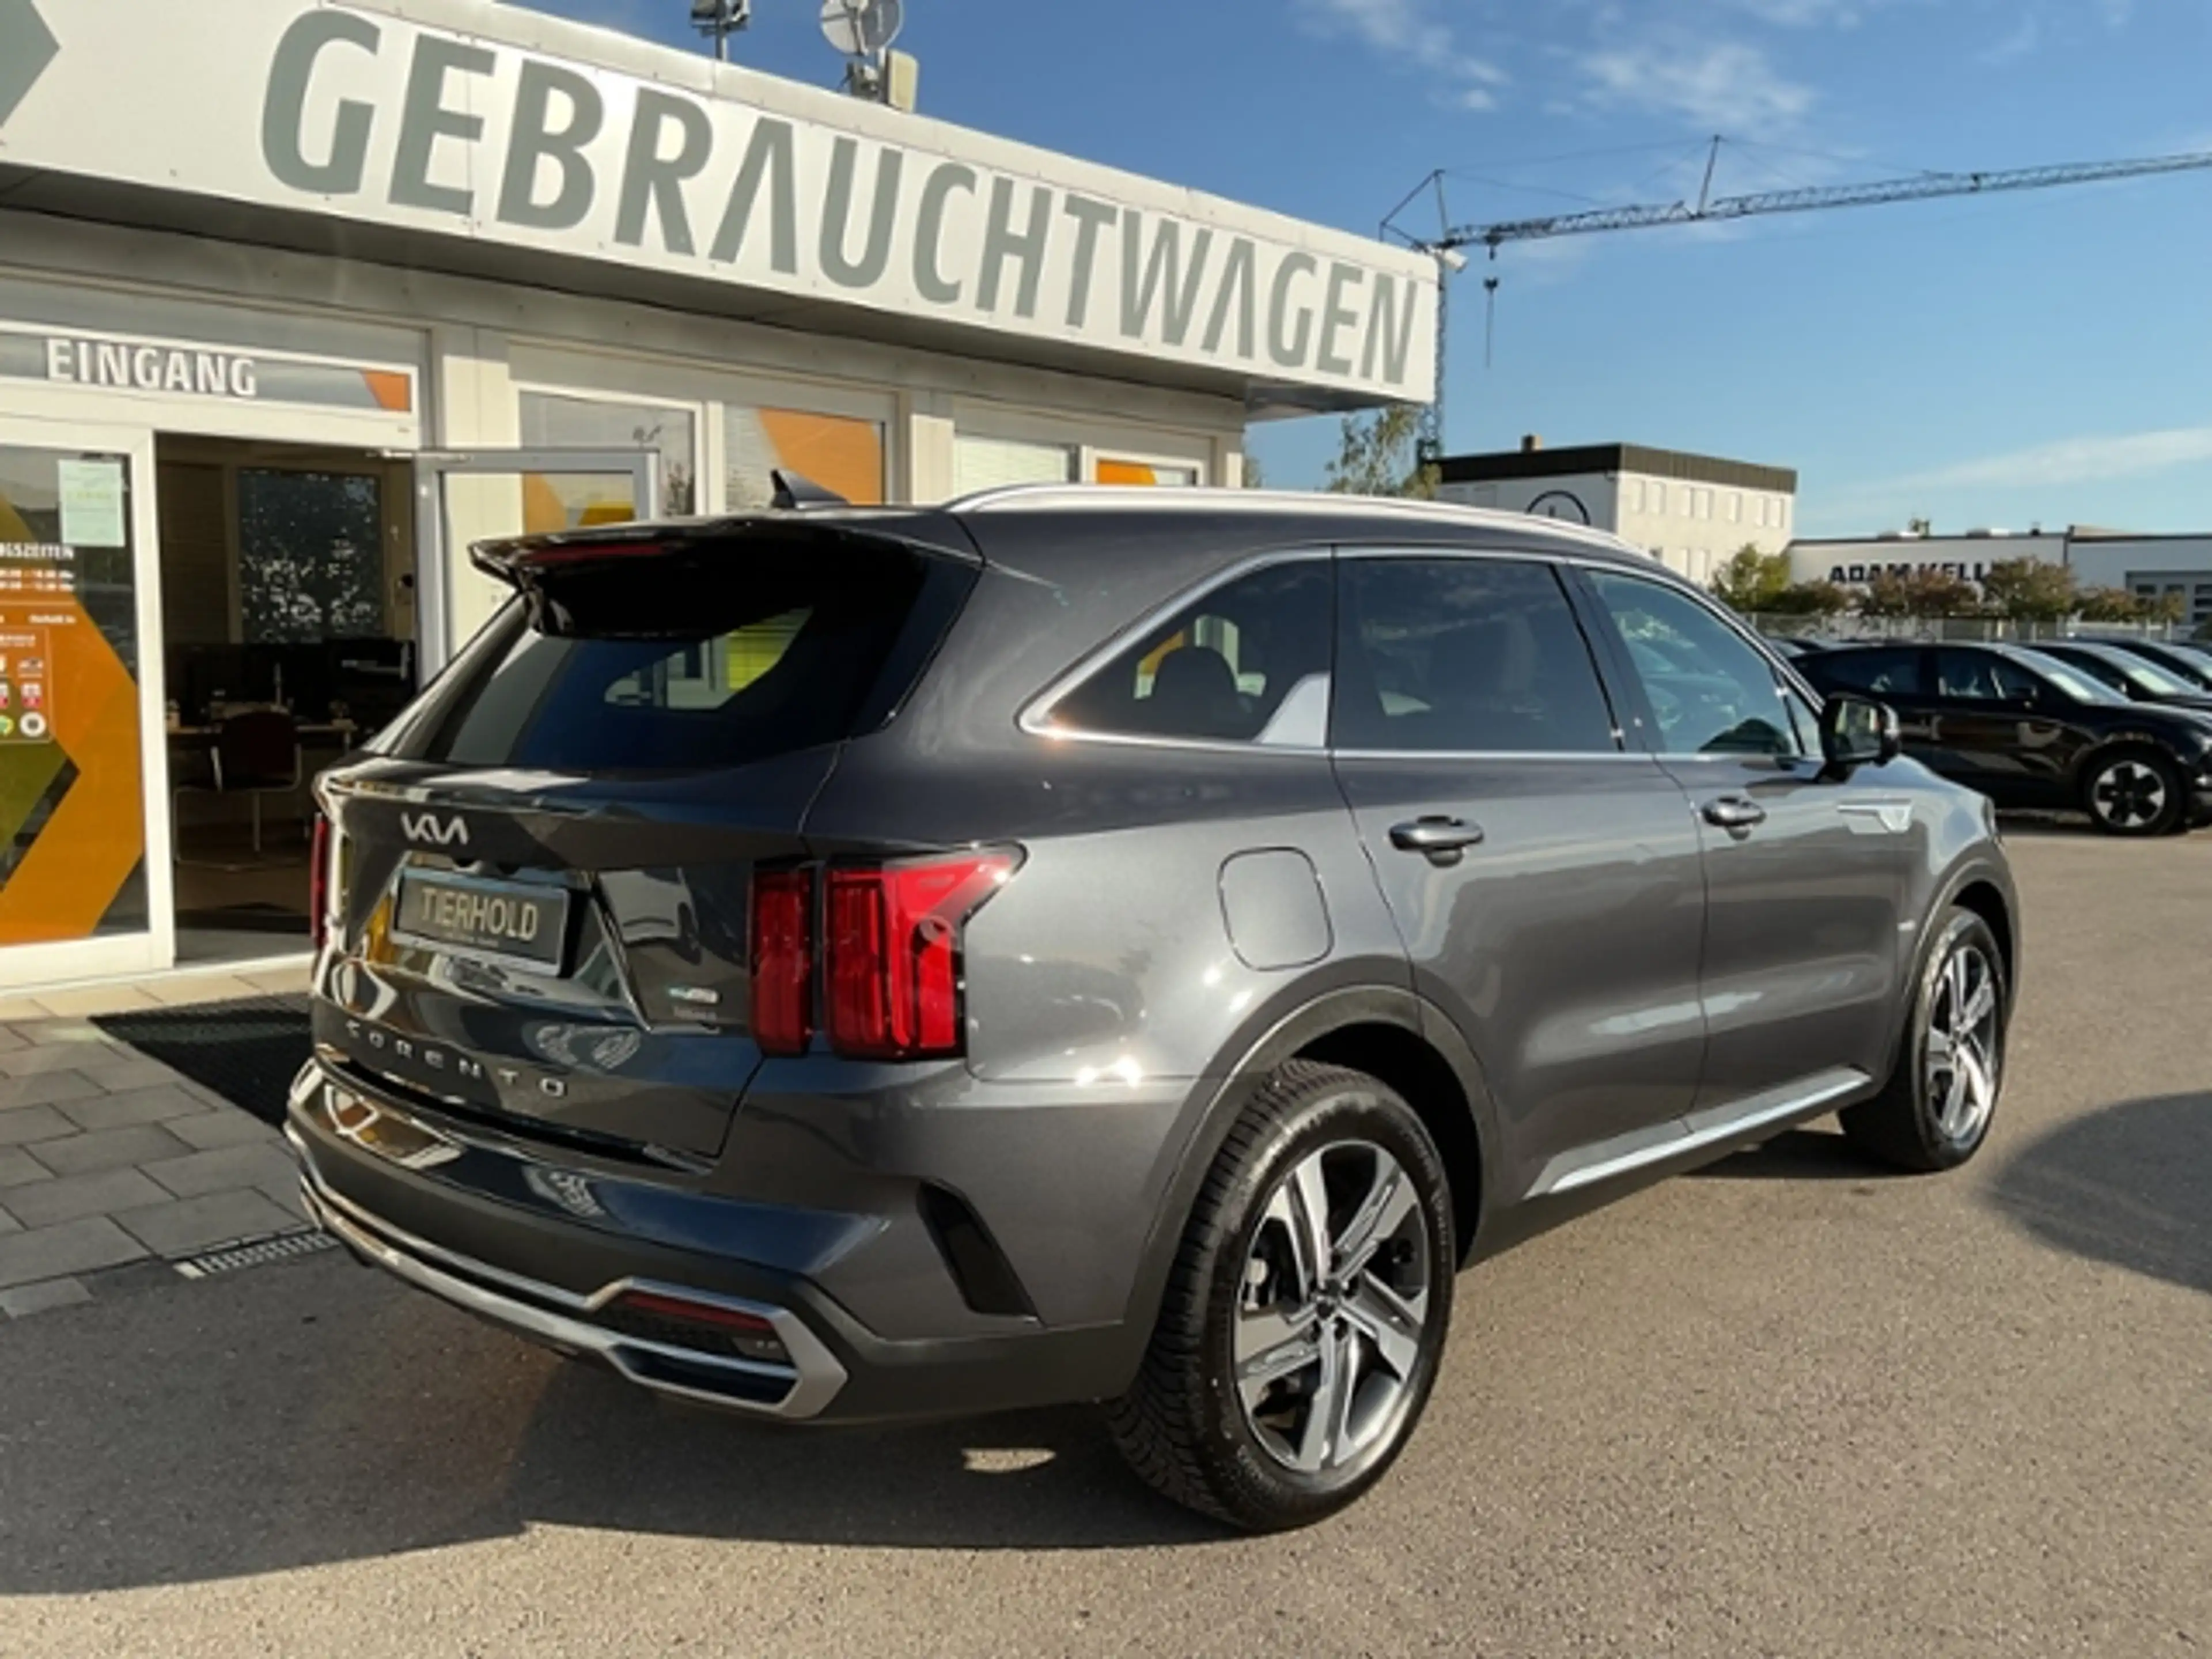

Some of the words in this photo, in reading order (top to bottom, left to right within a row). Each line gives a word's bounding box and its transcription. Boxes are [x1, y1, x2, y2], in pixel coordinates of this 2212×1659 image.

[262, 9, 1418, 384] GEBRAUCHTWAGEN
[46, 338, 257, 396] EINGANG
[400, 812, 470, 845] KIA
[422, 887, 538, 942] TIERHOLD
[347, 1020, 567, 1096] SORENTO
